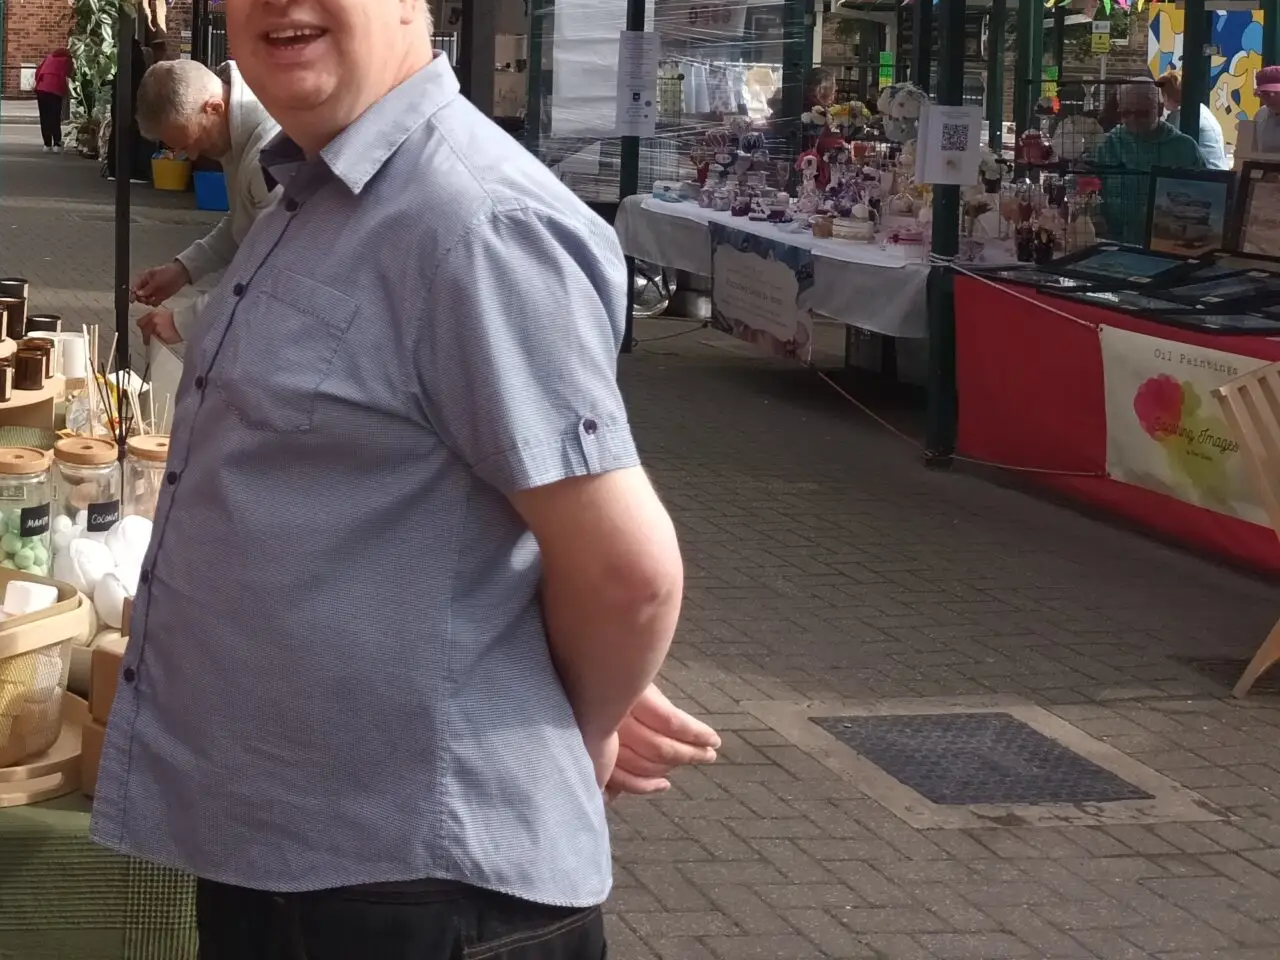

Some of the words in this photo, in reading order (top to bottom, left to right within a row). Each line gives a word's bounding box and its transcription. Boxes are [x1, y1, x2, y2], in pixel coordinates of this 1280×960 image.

[1153, 348, 1173, 362] Oil
[1179, 353, 1239, 375] Paintings
[1197, 428, 1239, 455] Images
[91, 512, 118, 525] COCONUT
